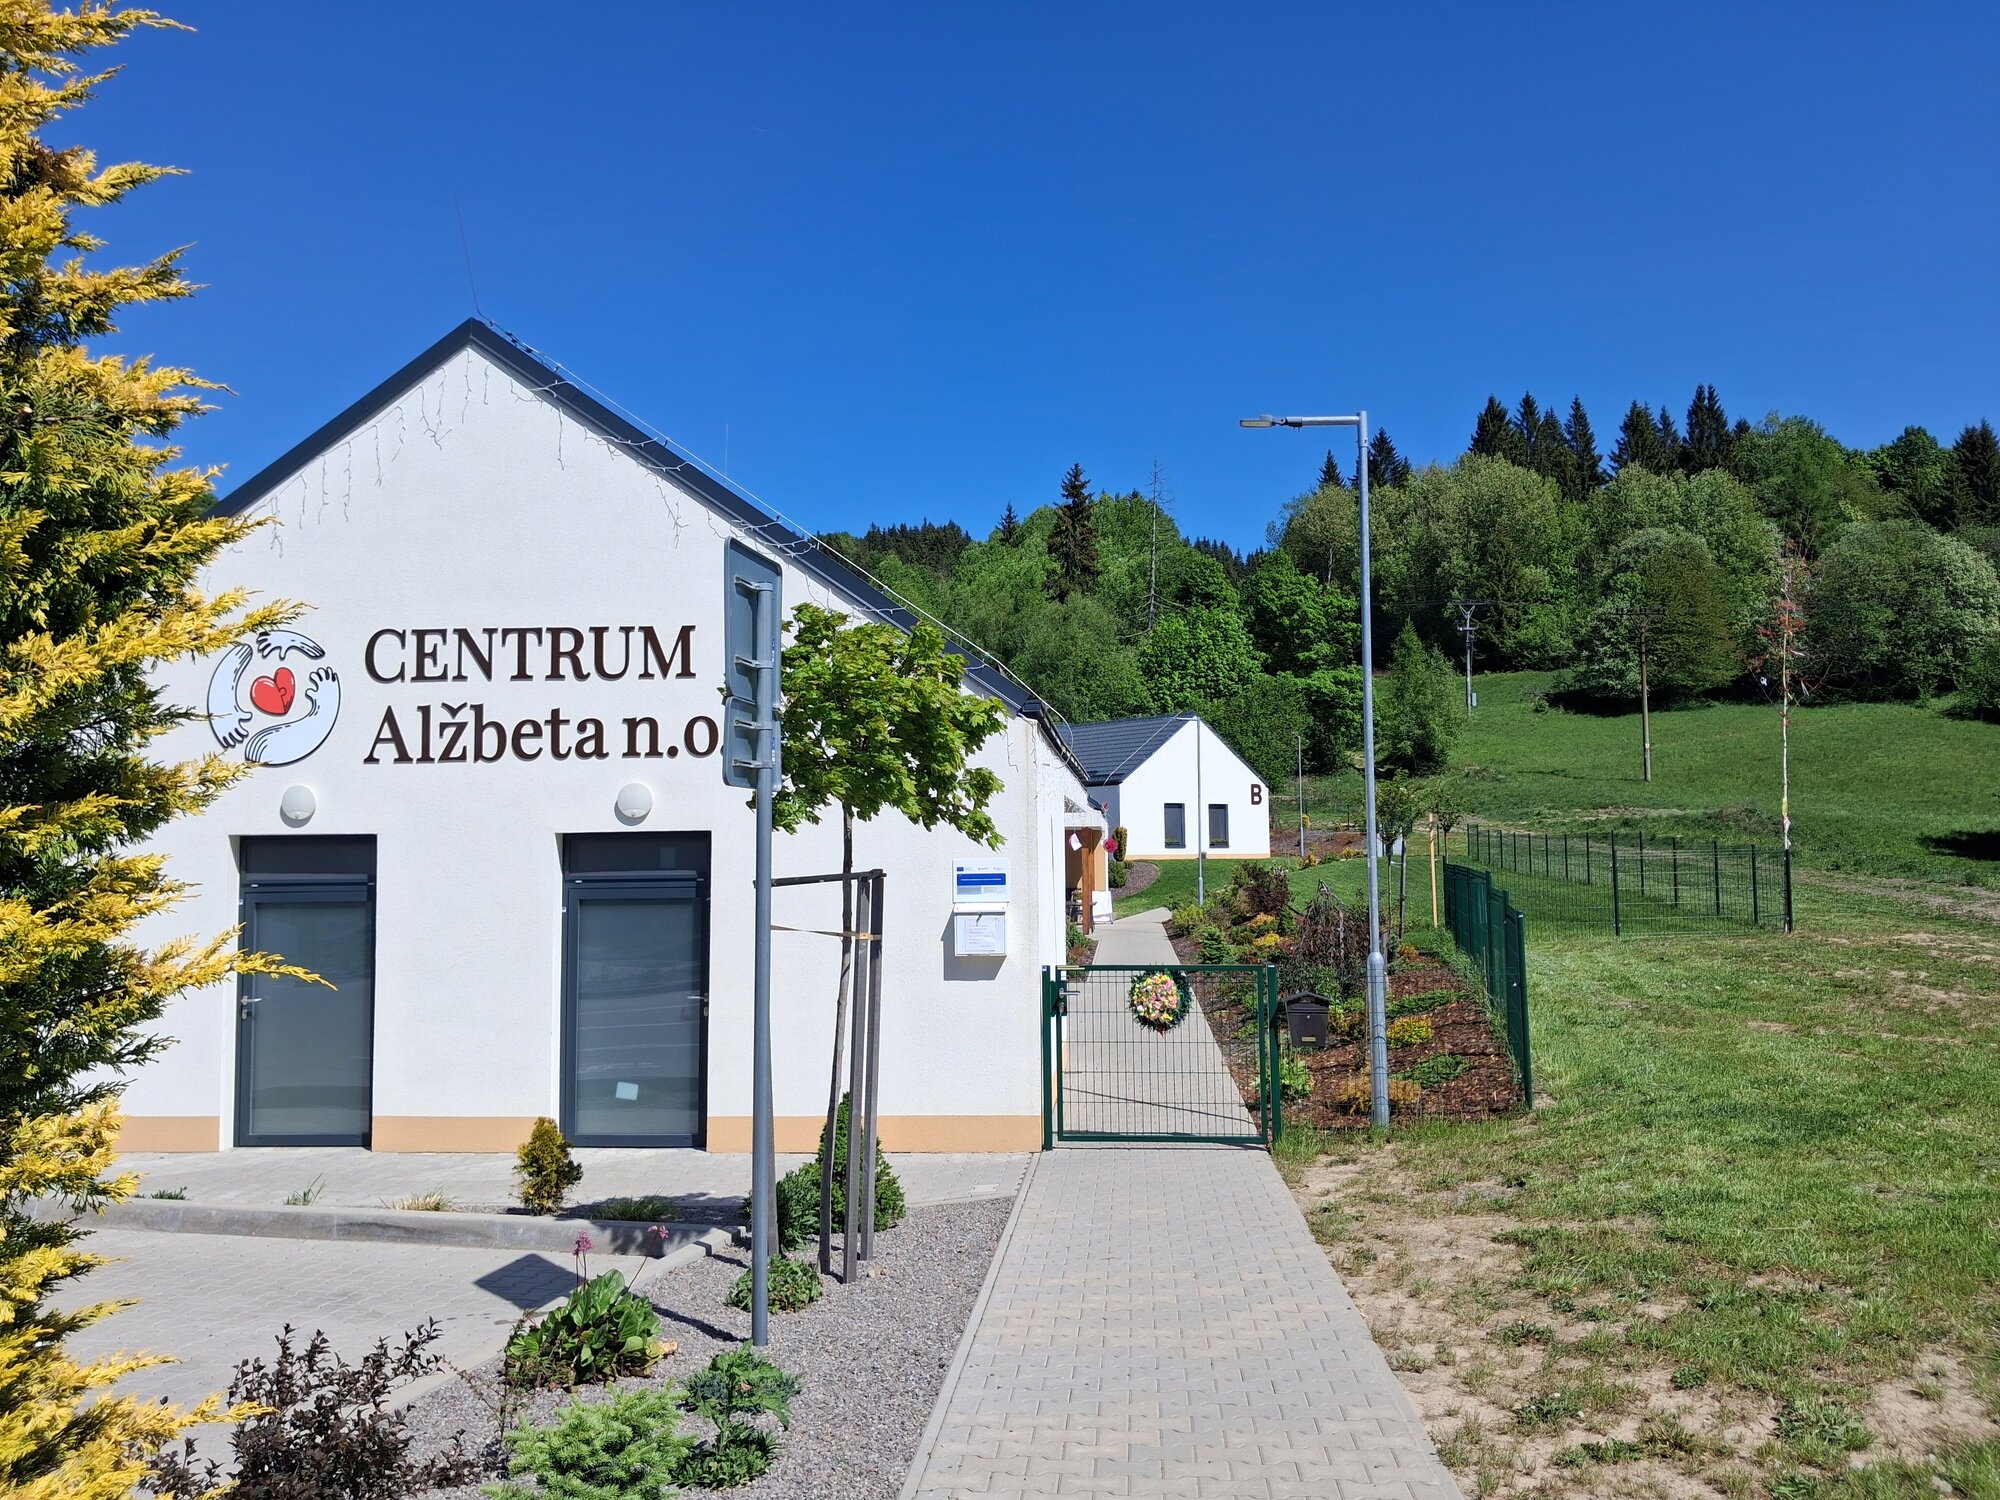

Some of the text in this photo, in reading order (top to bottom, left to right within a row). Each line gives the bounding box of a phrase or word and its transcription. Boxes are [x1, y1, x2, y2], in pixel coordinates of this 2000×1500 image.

[364, 625, 697, 682] CENTRUM
[363, 702, 610, 764] Alžbeta
[1250, 783, 1262, 805] B
